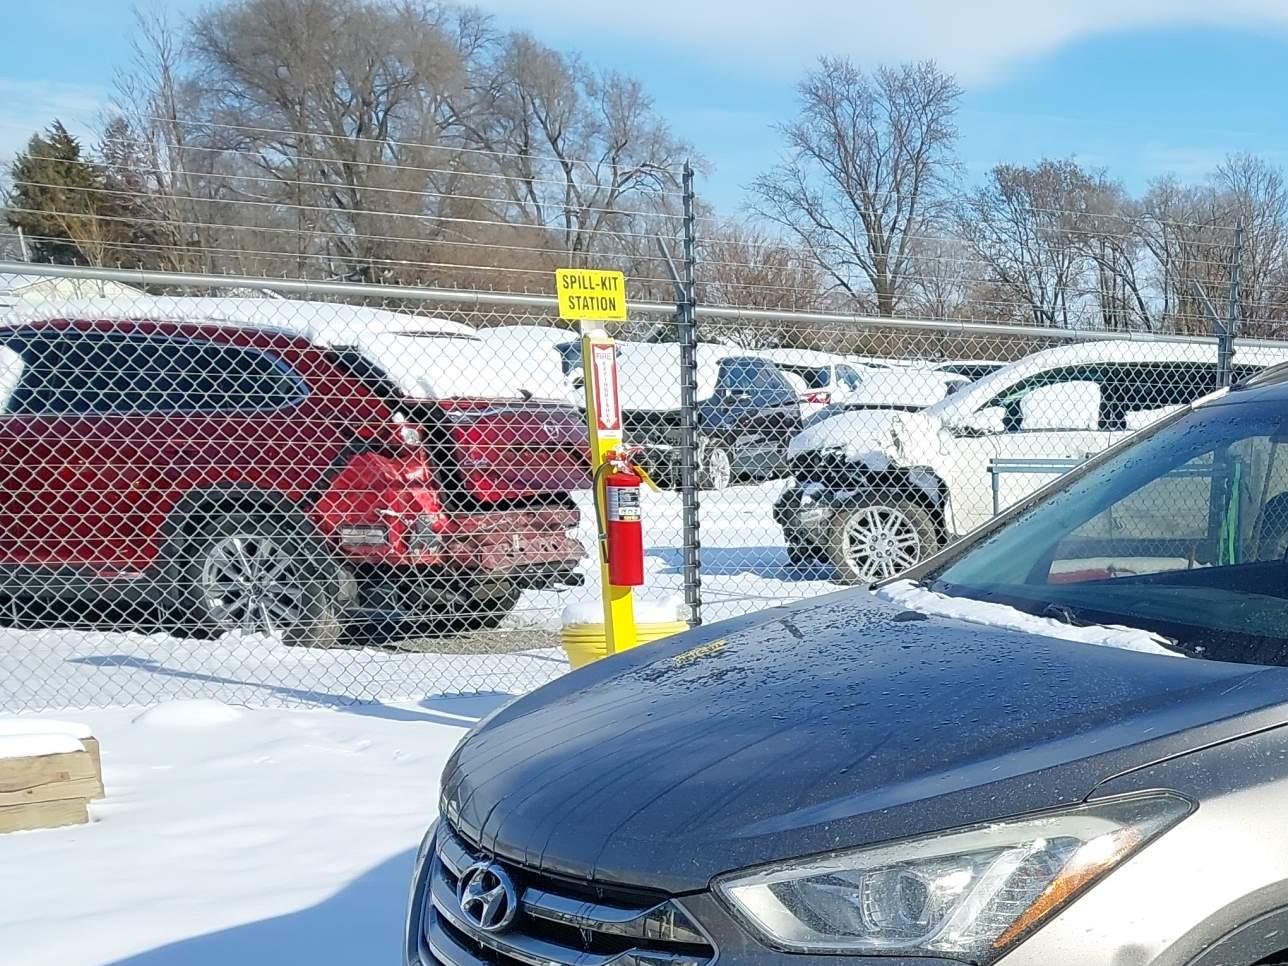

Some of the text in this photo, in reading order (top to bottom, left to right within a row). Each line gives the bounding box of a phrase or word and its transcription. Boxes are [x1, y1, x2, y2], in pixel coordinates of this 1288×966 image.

[562, 274, 619, 291] SPILL-KIT
[568, 295, 617, 312] STATION
[595, 352, 612, 361] FIRE
